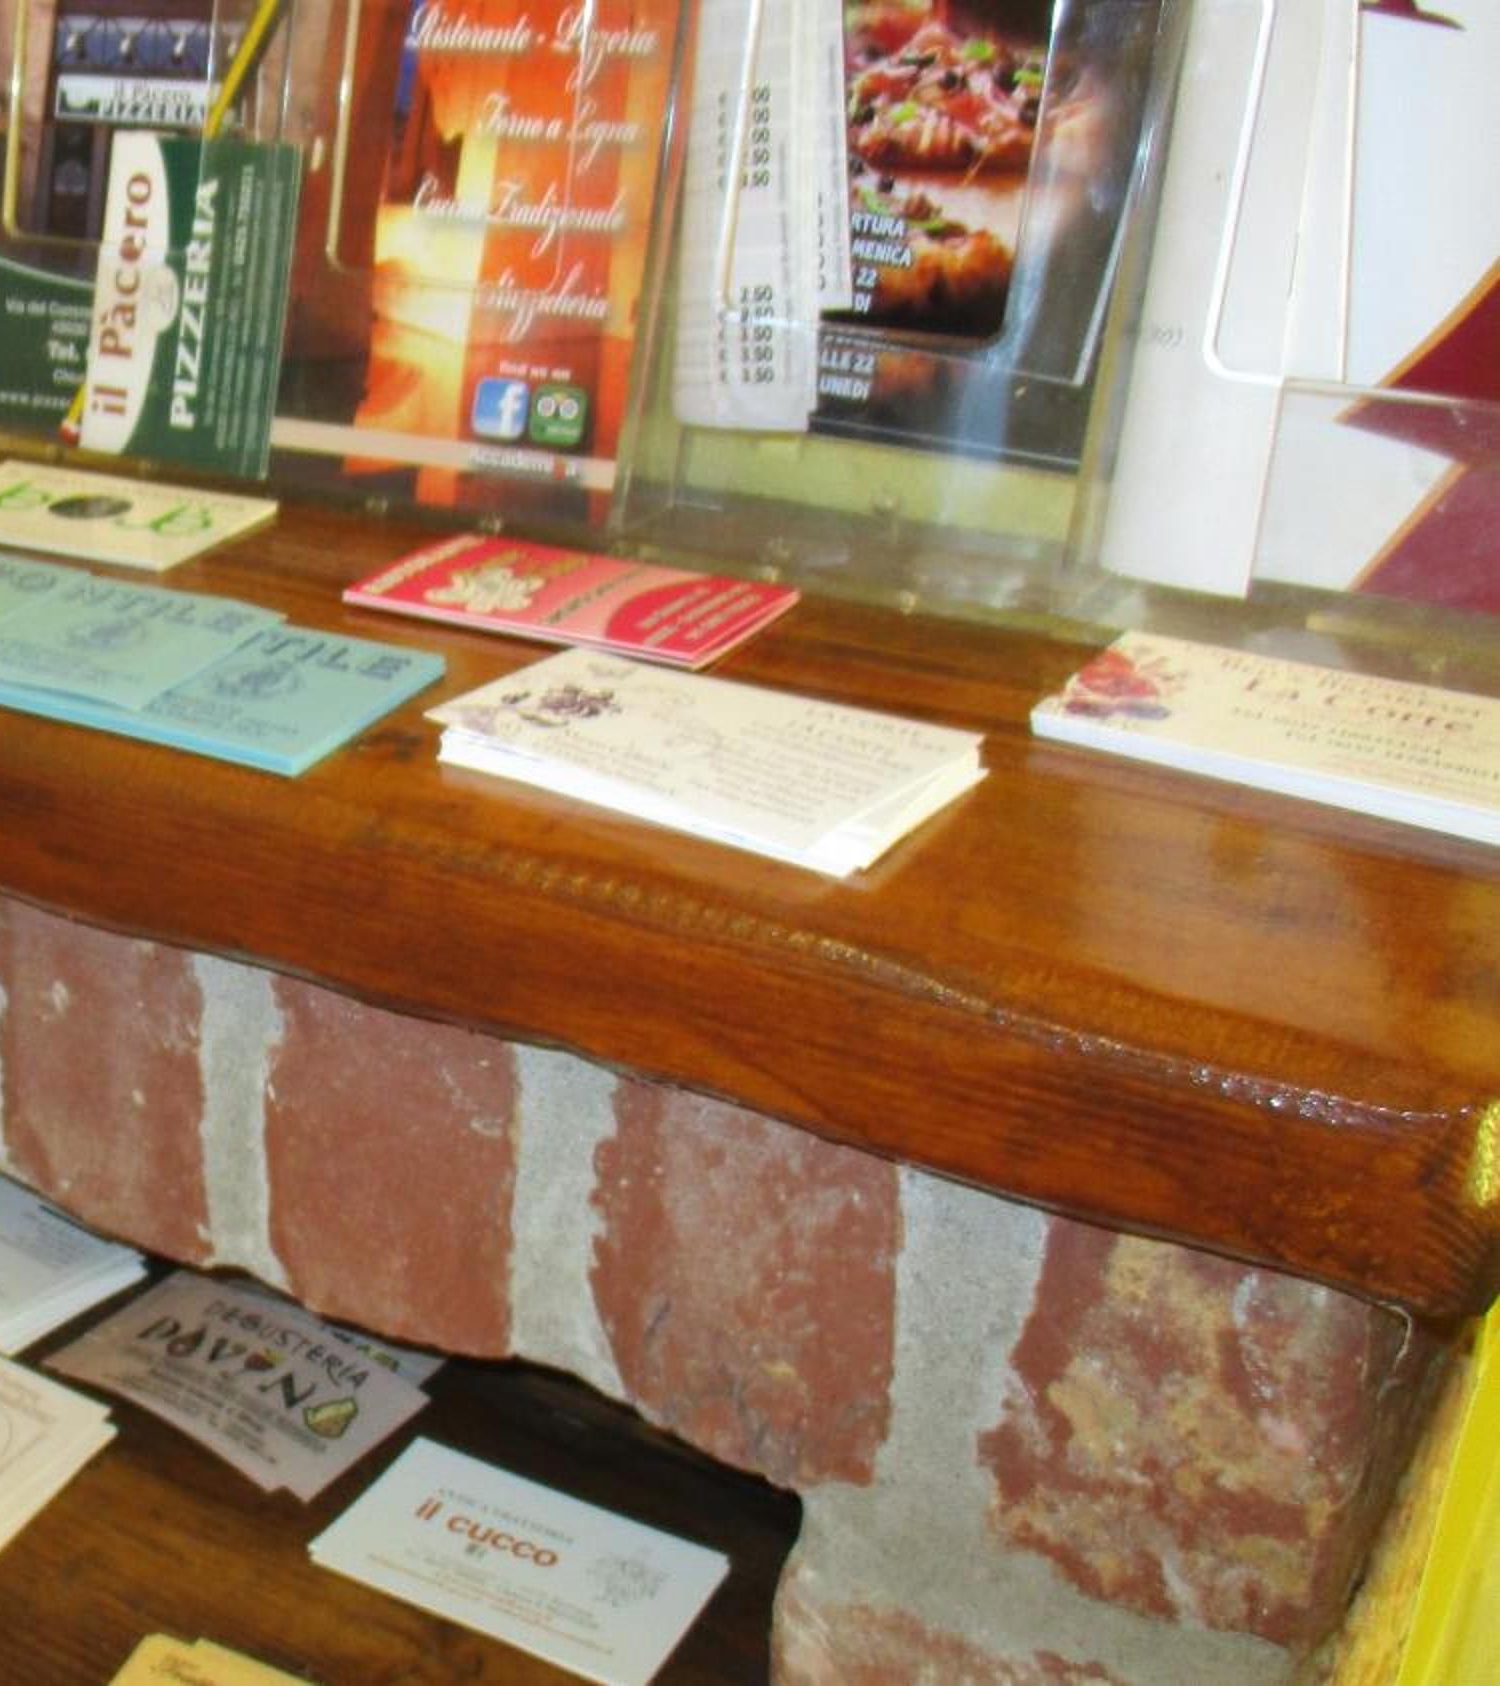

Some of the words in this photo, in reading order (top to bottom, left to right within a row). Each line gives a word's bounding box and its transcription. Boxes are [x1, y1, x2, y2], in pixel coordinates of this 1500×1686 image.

[851, 213, 905, 235] RTURA
[851, 240, 913, 266] MENICA
[169, 177, 220, 431] PIZZERIA
[92, 383, 129, 417] il
[414, 1496, 445, 1522] il
[445, 1513, 560, 1568] cucco
